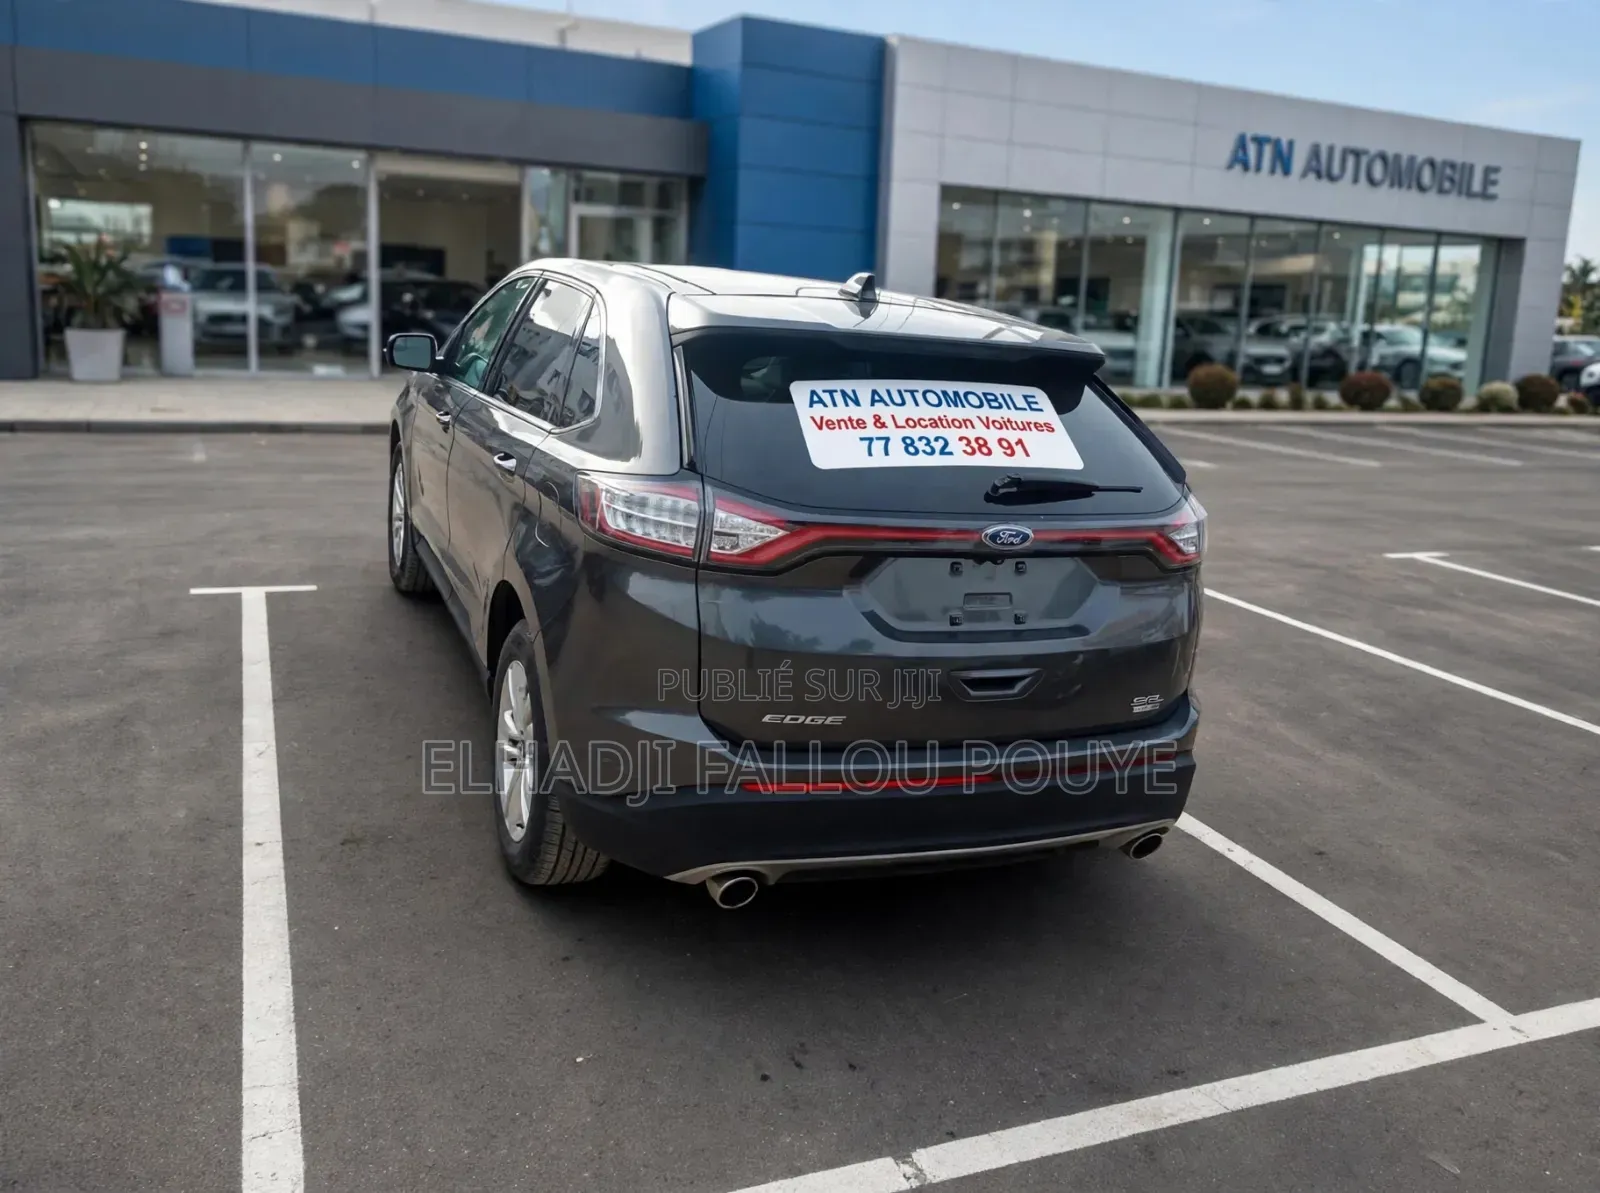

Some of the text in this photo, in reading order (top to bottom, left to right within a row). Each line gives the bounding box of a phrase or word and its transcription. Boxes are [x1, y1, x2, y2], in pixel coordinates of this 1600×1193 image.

[1226, 132, 1502, 201] ATN AUTOMOBILE
[808, 388, 1044, 412] ATN AUTOMOBILE
[810, 414, 1056, 434] Vente & Location Voitures
[858, 435, 1031, 458] 77 832 38 91
[996, 530, 1023, 544] Ford
[761, 713, 847, 725] EDGE
